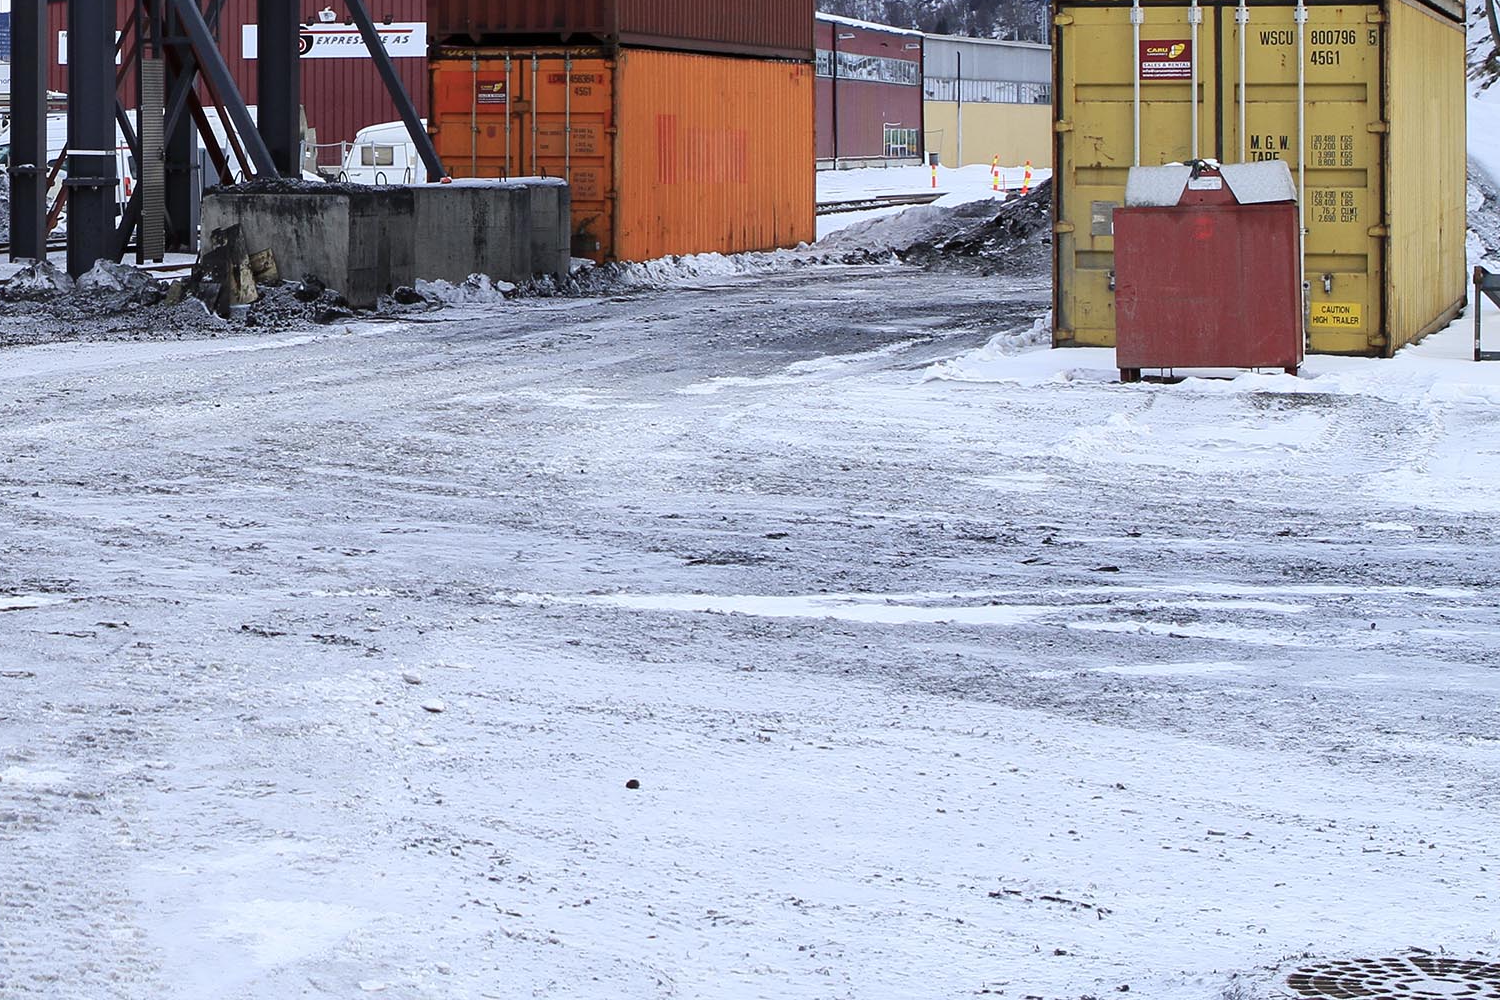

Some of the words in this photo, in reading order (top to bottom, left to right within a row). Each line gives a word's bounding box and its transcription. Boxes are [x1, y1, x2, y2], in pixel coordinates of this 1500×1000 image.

[393, 35, 410, 44] AS
[1260, 30, 1294, 45] WSCU
[1311, 30, 1356, 45] 800796
[1369, 30, 1377, 45] 5
[1311, 51, 1341, 65] 45G1
[1321, 305, 1350, 313] CAUTION
[1312, 315, 1328, 324] HIGH
[1332, 316, 1359, 324] TRAILER
